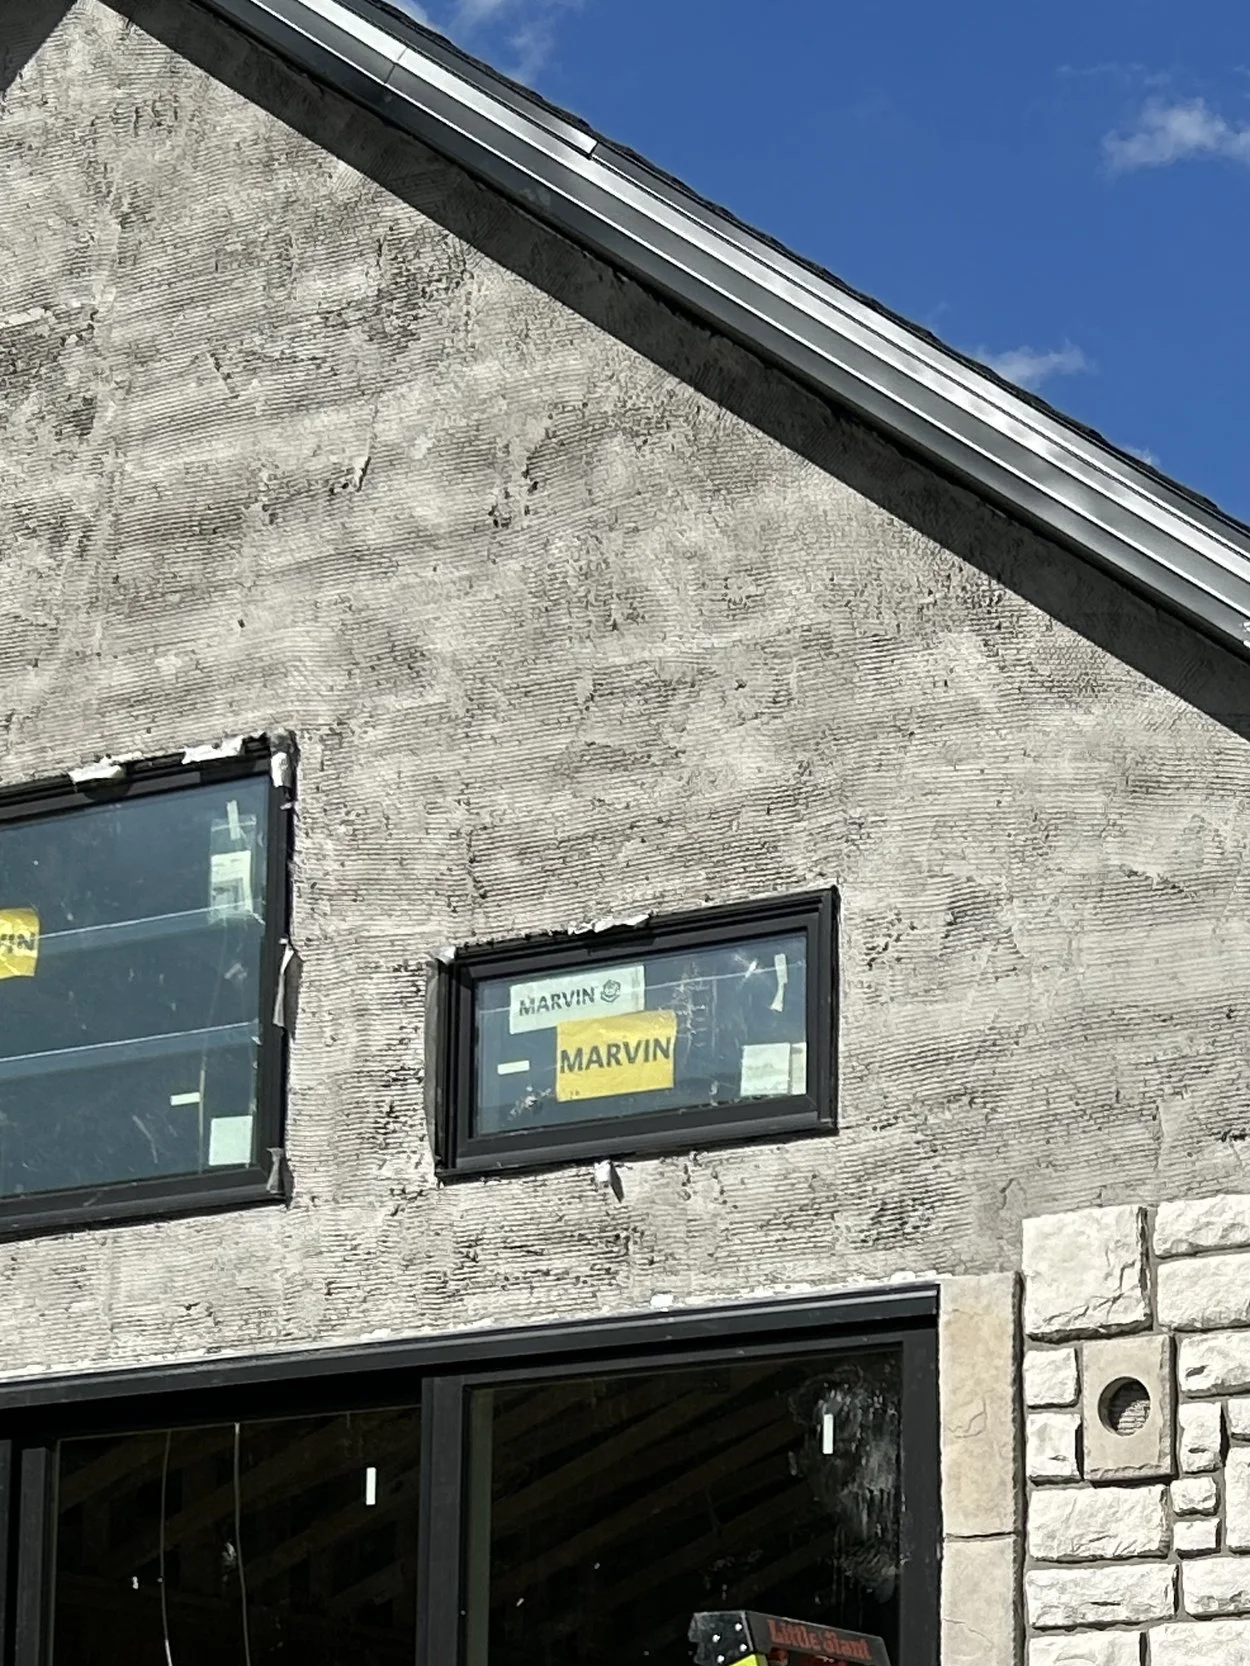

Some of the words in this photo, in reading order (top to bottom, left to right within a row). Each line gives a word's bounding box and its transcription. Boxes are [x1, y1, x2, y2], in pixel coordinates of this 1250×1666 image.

[519, 986, 596, 1016] MARVIN
[559, 1037, 672, 1074] MARVIN
[767, 1618, 821, 1651] Little
[823, 1628, 872, 1661] Giant
